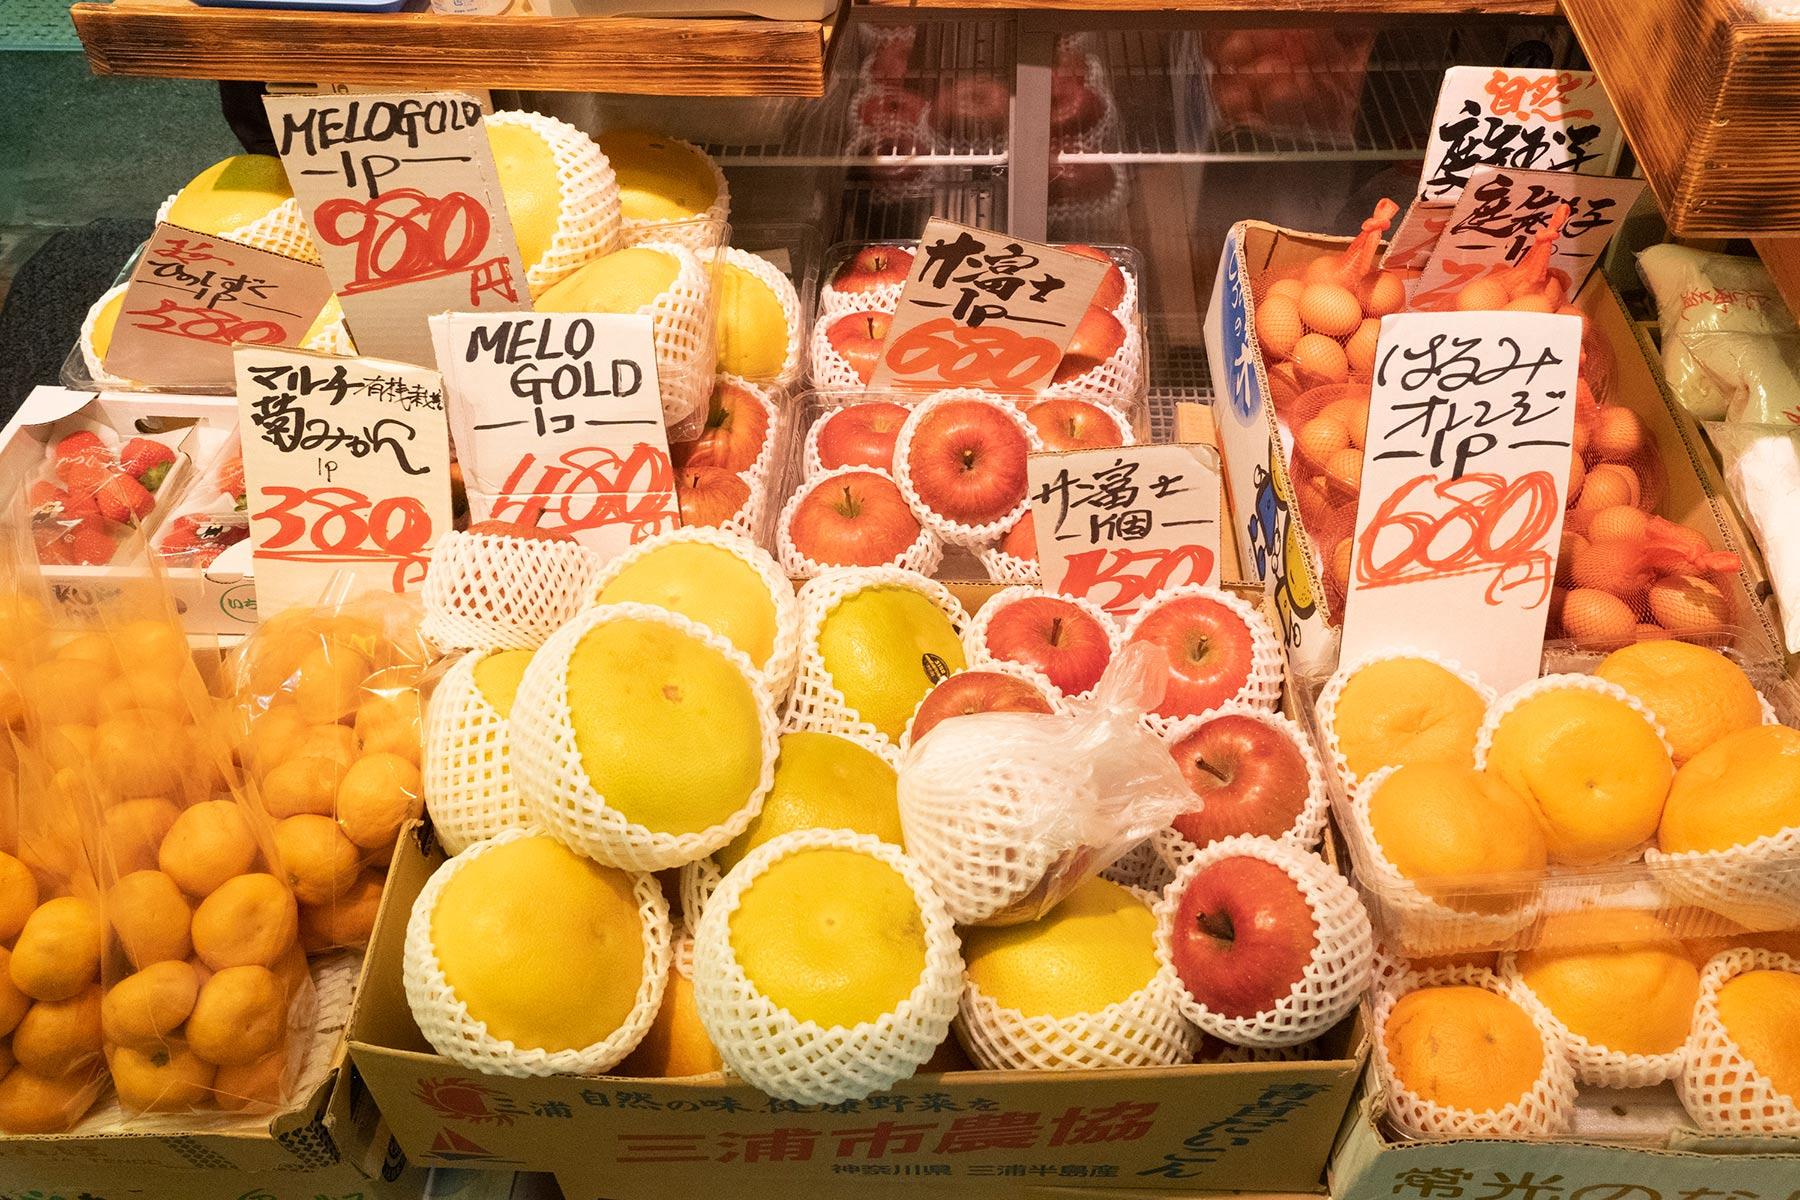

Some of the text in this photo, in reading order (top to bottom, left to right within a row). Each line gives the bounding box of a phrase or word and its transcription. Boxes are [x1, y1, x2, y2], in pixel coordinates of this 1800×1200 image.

[280, 100, 483, 156] MELOGOLD
[465, 318, 595, 364] MELO
[885, 318, 1061, 388] 680
[1377, 334, 1563, 391] はるみ
[248, 365, 365, 405] マルチ
[510, 359, 643, 405] GOLD
[251, 393, 430, 475] 菊みかん
[1384, 391, 1566, 439] オレンジ
[251, 486, 432, 554] 380
[616, 1100, 1160, 1163] 三浦市農協
[831, 1163, 1120, 1178] 神奈川県 三浦半島産
